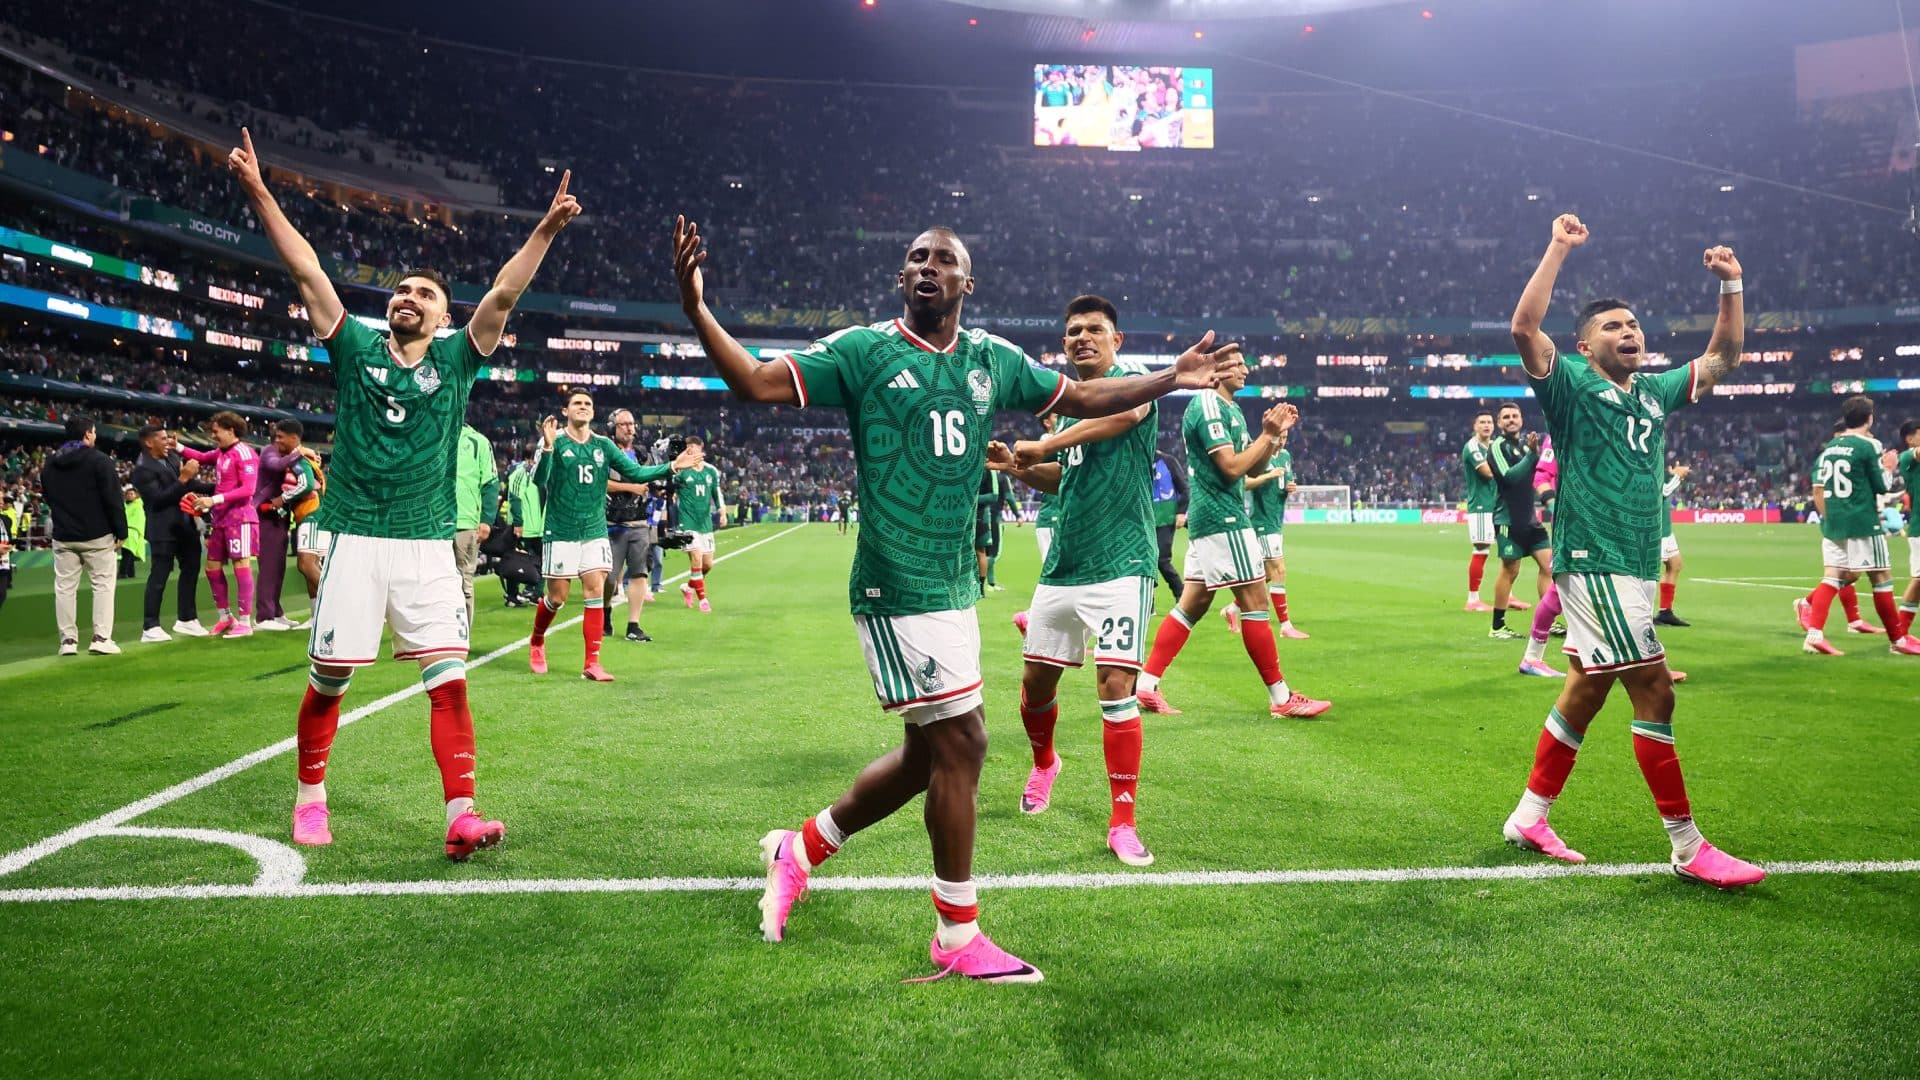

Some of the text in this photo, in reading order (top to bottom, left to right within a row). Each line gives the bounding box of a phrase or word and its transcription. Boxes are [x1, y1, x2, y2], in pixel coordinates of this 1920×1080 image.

[215, 228, 240, 244] CITY
[209, 285, 264, 309] MEXICO CITY
[966, 318, 1057, 326] MEICO CITY
[206, 330, 263, 352] MEXICO CITY
[547, 338, 620, 352] MEXICO CITY
[1362, 355, 1388, 366] CITY
[1763, 352, 1793, 362] CITY
[547, 371, 620, 385] MEXICO CITY
[1317, 386, 1389, 397] MEXICO CITY
[1713, 383, 1796, 395] MEXICO CITY
[386, 396, 406, 423] 5
[930, 410, 966, 456] 16
[1627, 415, 1652, 453] 17
[578, 465, 594, 484] 15
[1816, 459, 1853, 498] 26
[1326, 510, 1398, 523] aramco
[1694, 510, 1745, 523] Lenovo
[229, 539, 241, 554] 13
[301, 534, 308, 547] 7
[1098, 616, 1134, 650] 23
